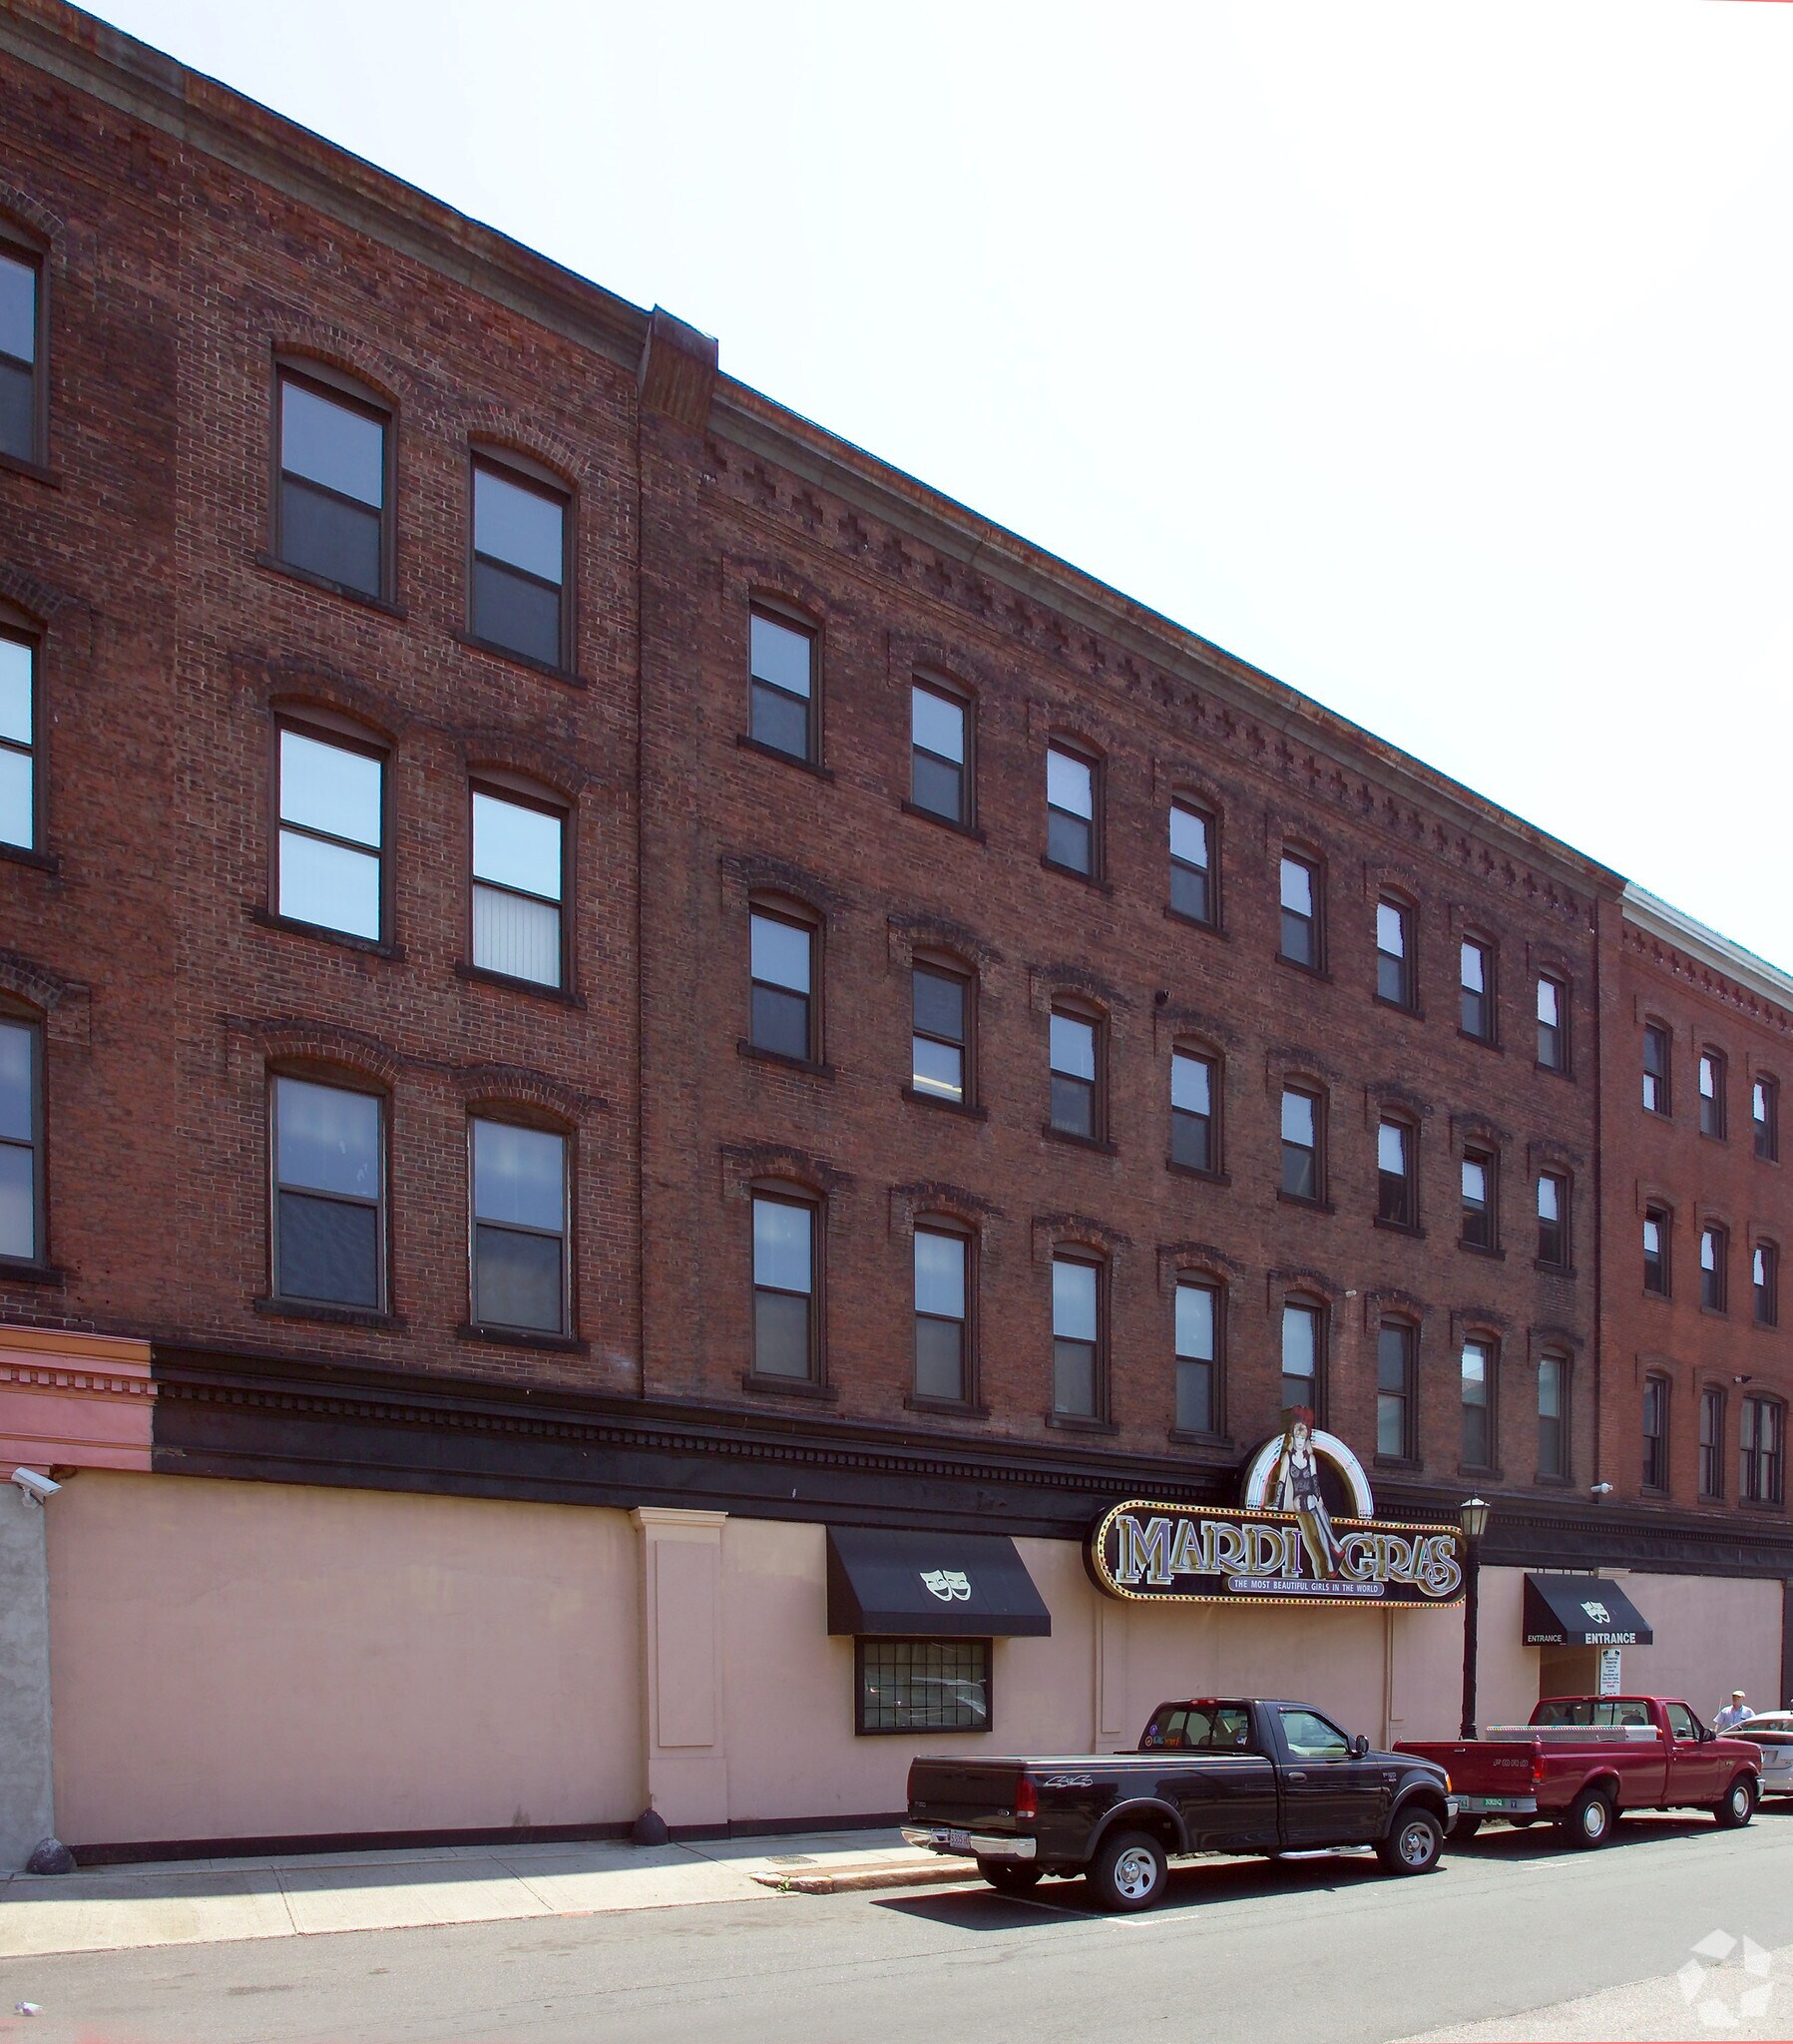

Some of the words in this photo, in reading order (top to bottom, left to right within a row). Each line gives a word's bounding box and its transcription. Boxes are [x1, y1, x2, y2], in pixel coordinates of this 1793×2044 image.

[1117, 1515, 1303, 1585] MARDI
[1339, 1531, 1462, 1597] GRAS
[1234, 1579, 1248, 1588] THE
[1251, 1580, 1270, 1589] MOST
[1273, 1581, 1308, 1591] BEAUTIFUL
[1311, 1582, 1330, 1591] GIRLS
[1342, 1583, 1354, 1592] THE
[1356, 1584, 1378, 1593] WORLD
[1528, 1634, 1562, 1643] ENTRANCE
[1584, 1633, 1636, 1644] ENTRANCE
[1493, 1759, 1529, 1768] FORD
